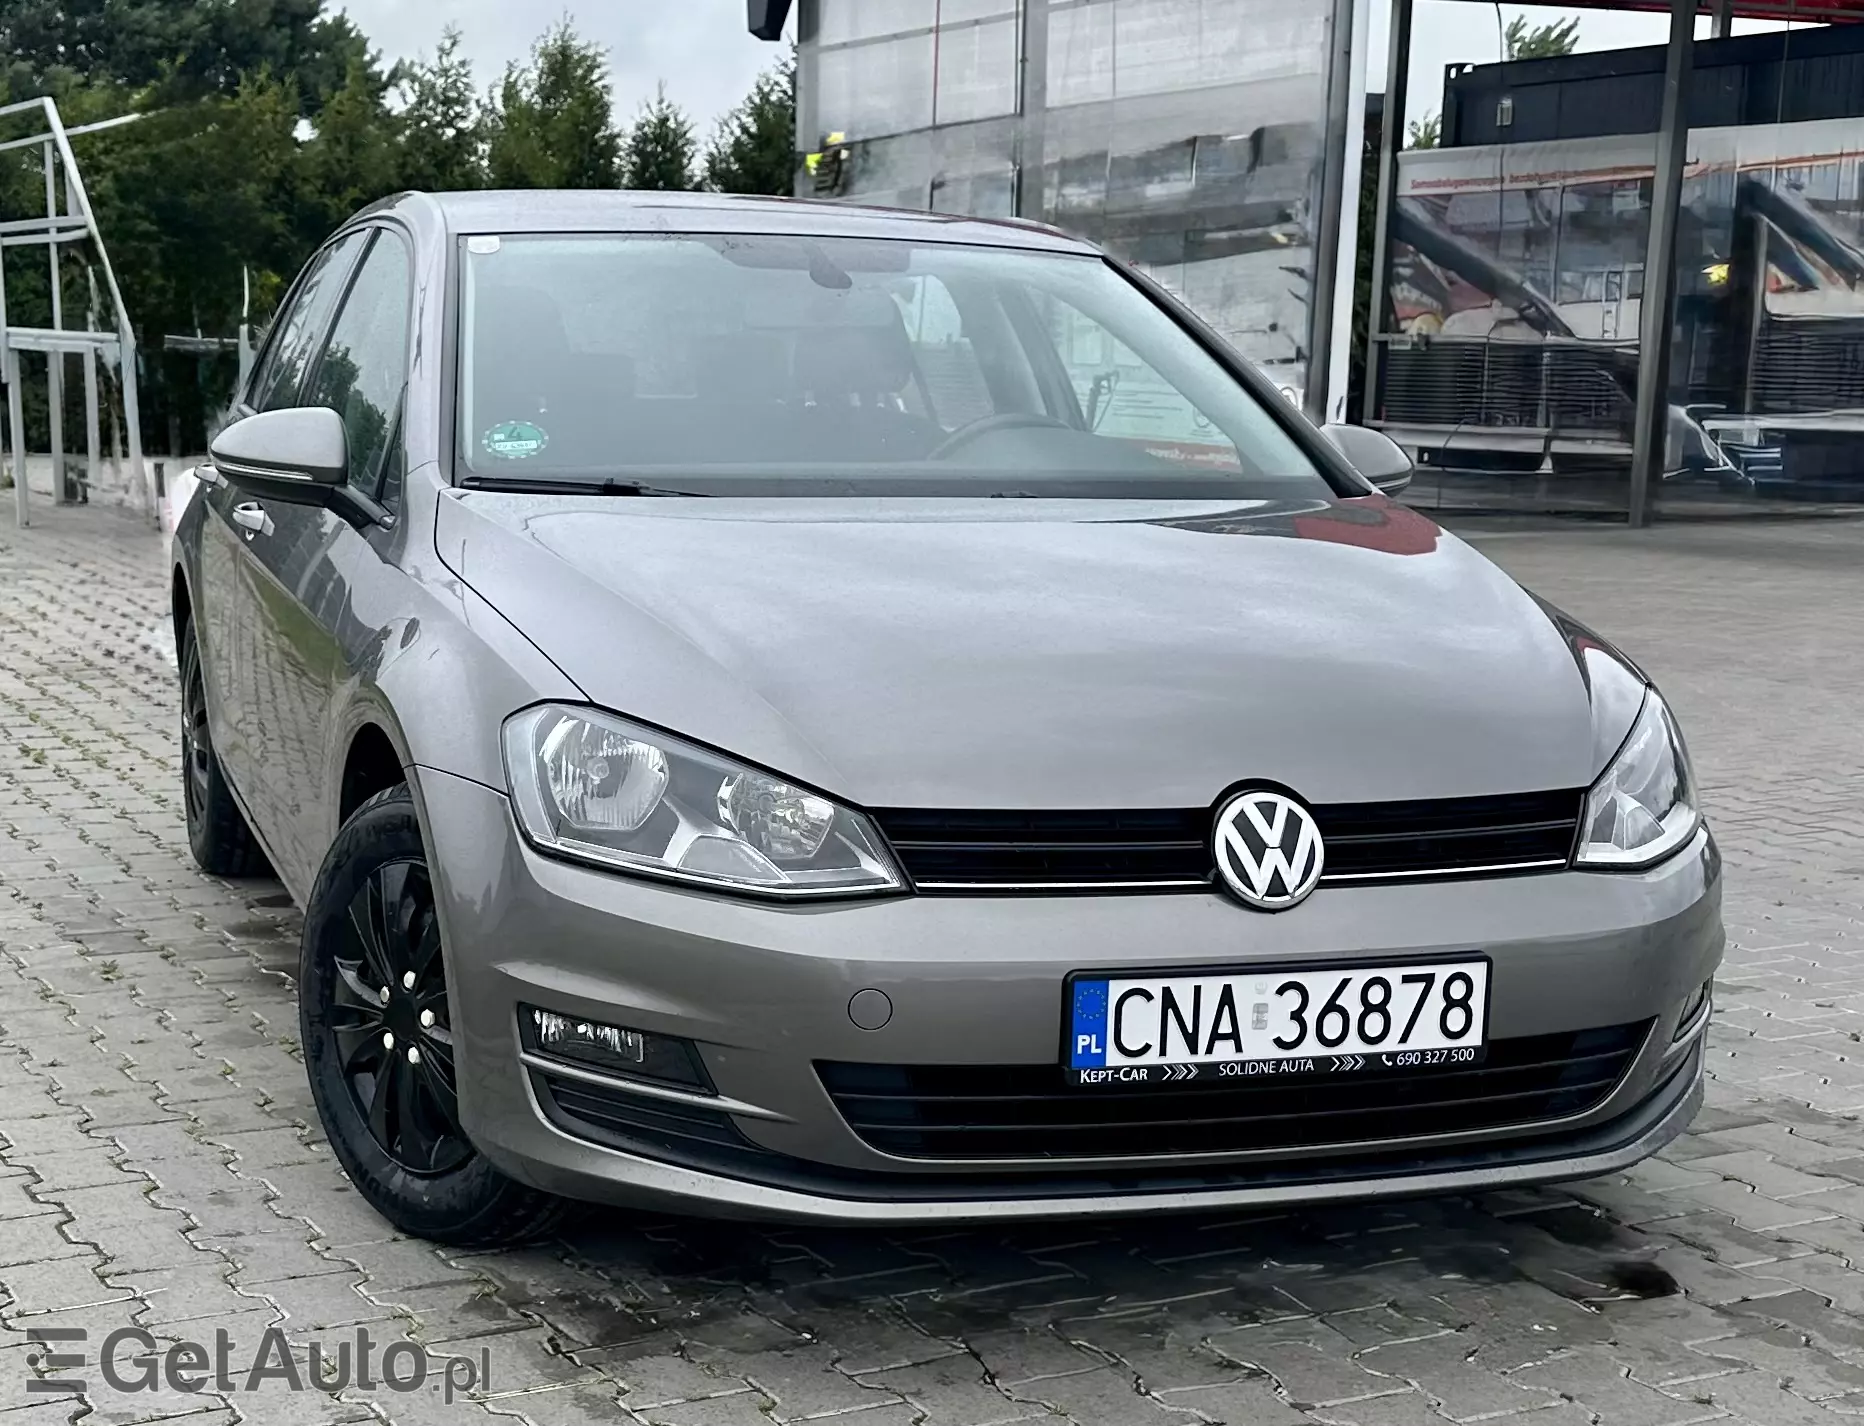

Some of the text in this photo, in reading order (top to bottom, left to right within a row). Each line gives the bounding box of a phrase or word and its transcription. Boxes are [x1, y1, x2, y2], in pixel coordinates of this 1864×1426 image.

[1216, 792, 1322, 904] VW
[1113, 971, 1475, 1058] CNA 36878
[1077, 1034, 1102, 1055] PL
[1218, 1059, 1314, 1076] SOLIDNE AUTA
[1396, 1048, 1475, 1066] 690 327 500
